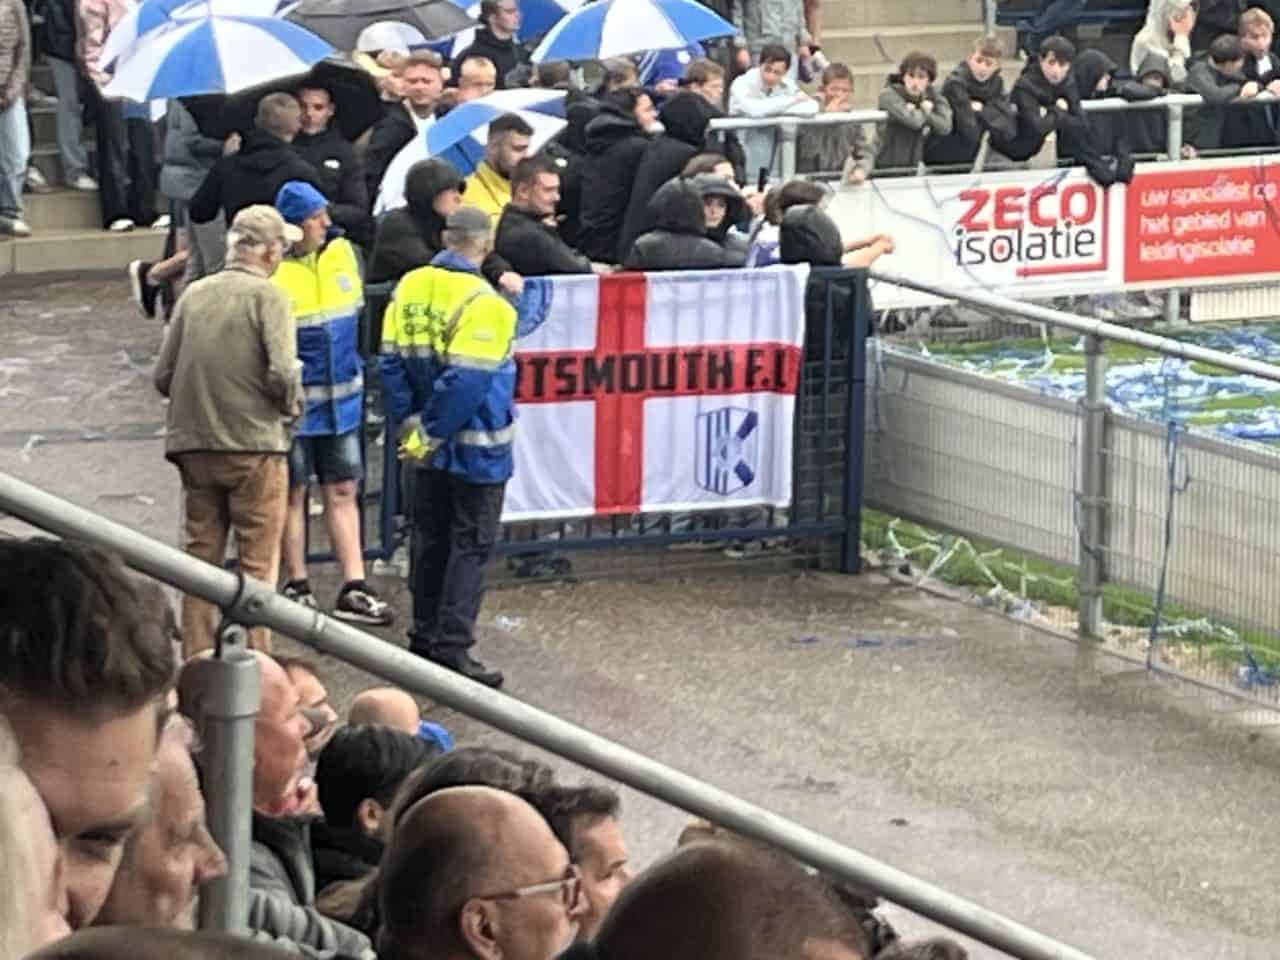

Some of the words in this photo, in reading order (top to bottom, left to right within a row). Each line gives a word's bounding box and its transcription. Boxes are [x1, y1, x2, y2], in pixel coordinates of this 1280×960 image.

[957, 182, 1098, 232] ZECO
[1172, 206, 1232, 238] gebied
[1233, 209, 1268, 229] van
[955, 220, 1097, 267] isolatie
